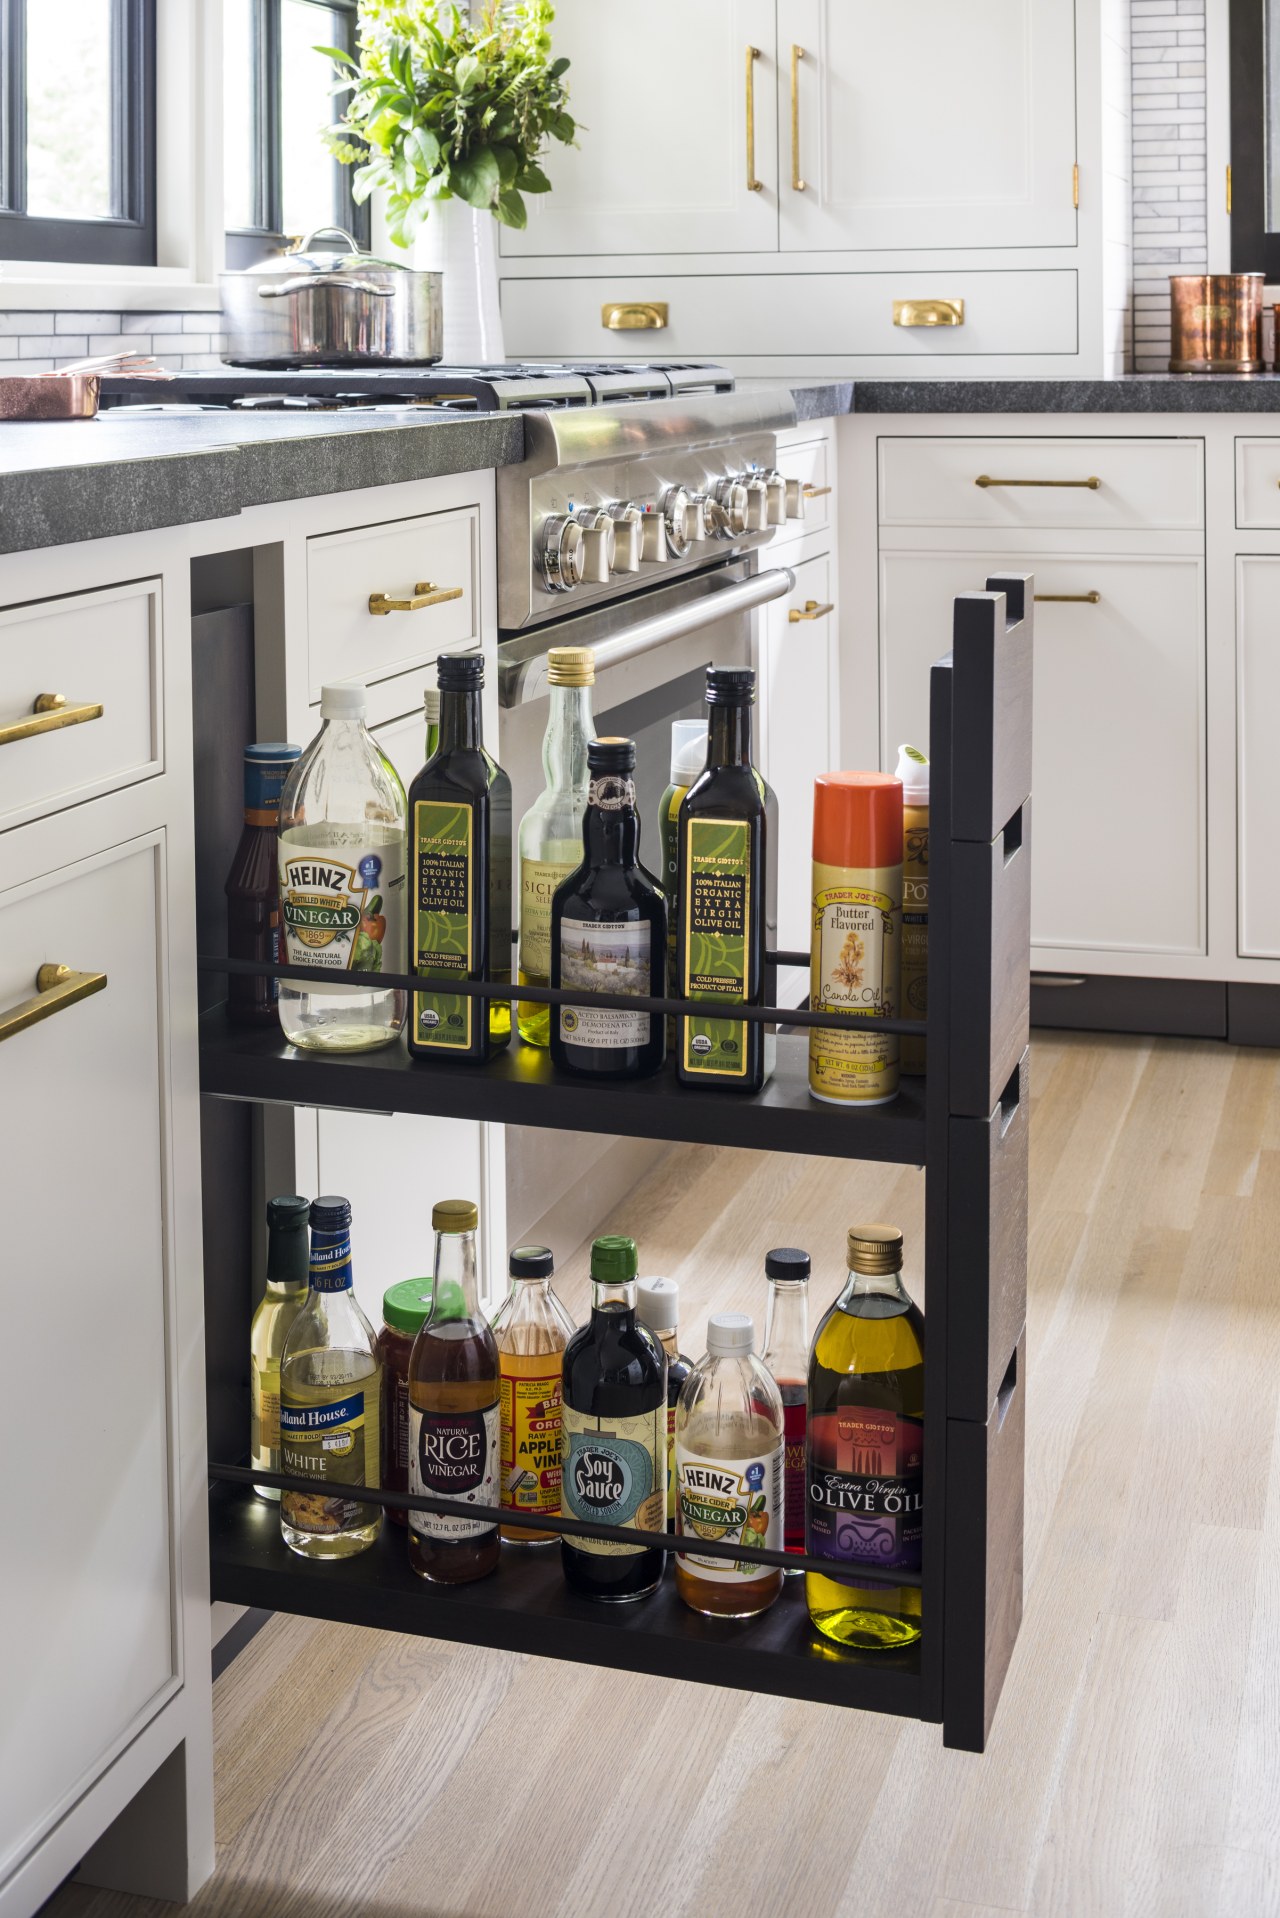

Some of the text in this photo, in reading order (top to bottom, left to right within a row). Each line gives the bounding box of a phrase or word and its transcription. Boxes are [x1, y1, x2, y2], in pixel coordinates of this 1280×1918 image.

[439, 860, 465, 868] ITALIAN
[422, 868, 465, 878] ORGANIC
[289, 866, 346, 892] HEINZ
[422, 878, 465, 888] EXTRA
[713, 880, 742, 888] ITALIAN
[422, 887, 465, 898] VIRGIN
[695, 888, 741, 899] ORGANIC
[824, 892, 878, 902] TRADER JOE'S
[292, 895, 342, 908] DISTILLED WHITE
[422, 897, 465, 907] OLIVE OIL
[695, 898, 741, 909] EXTRA
[285, 905, 354, 925] VINEGAR
[695, 908, 741, 918] VIRGIN
[836, 906, 870, 919] Butter
[695, 918, 741, 929] OLIVE OIL
[830, 918, 874, 931] Flavored
[304, 930, 325, 940] 1869
[293, 949, 303, 957] THE
[313, 951, 341, 959] NATURAL
[725, 984, 743, 993] ITALY
[822, 984, 880, 1002] Canola Oil
[314, 1277, 346, 1288] 16 FL OZ
[308, 1407, 346, 1426] House
[436, 1427, 469, 1436] NATURAL
[838, 1422, 895, 1433] TRADER GIOTTO'S
[424, 1433, 480, 1466] RICE
[519, 1438, 561, 1454] APPLE
[284, 1448, 327, 1471] WHITE
[576, 1446, 620, 1462] TRADER JOE'S
[428, 1463, 481, 1477] VINEGAR
[583, 1451, 613, 1483] Soy
[576, 1470, 622, 1500] Sauce
[686, 1469, 735, 1495] HEINZ
[824, 1474, 908, 1498] Extra Virgin
[689, 1494, 730, 1508] APPLE CIDER
[810, 1484, 923, 1513] OLIVE OIL
[578, 1498, 622, 1516] REDUCED SODIUM
[682, 1499, 741, 1523] VINEGAR
[423, 1520, 431, 1529] NET
[813, 1518, 828, 1527] COLD
[699, 1525, 717, 1535] 1869
[811, 1524, 832, 1535] PRESSED
